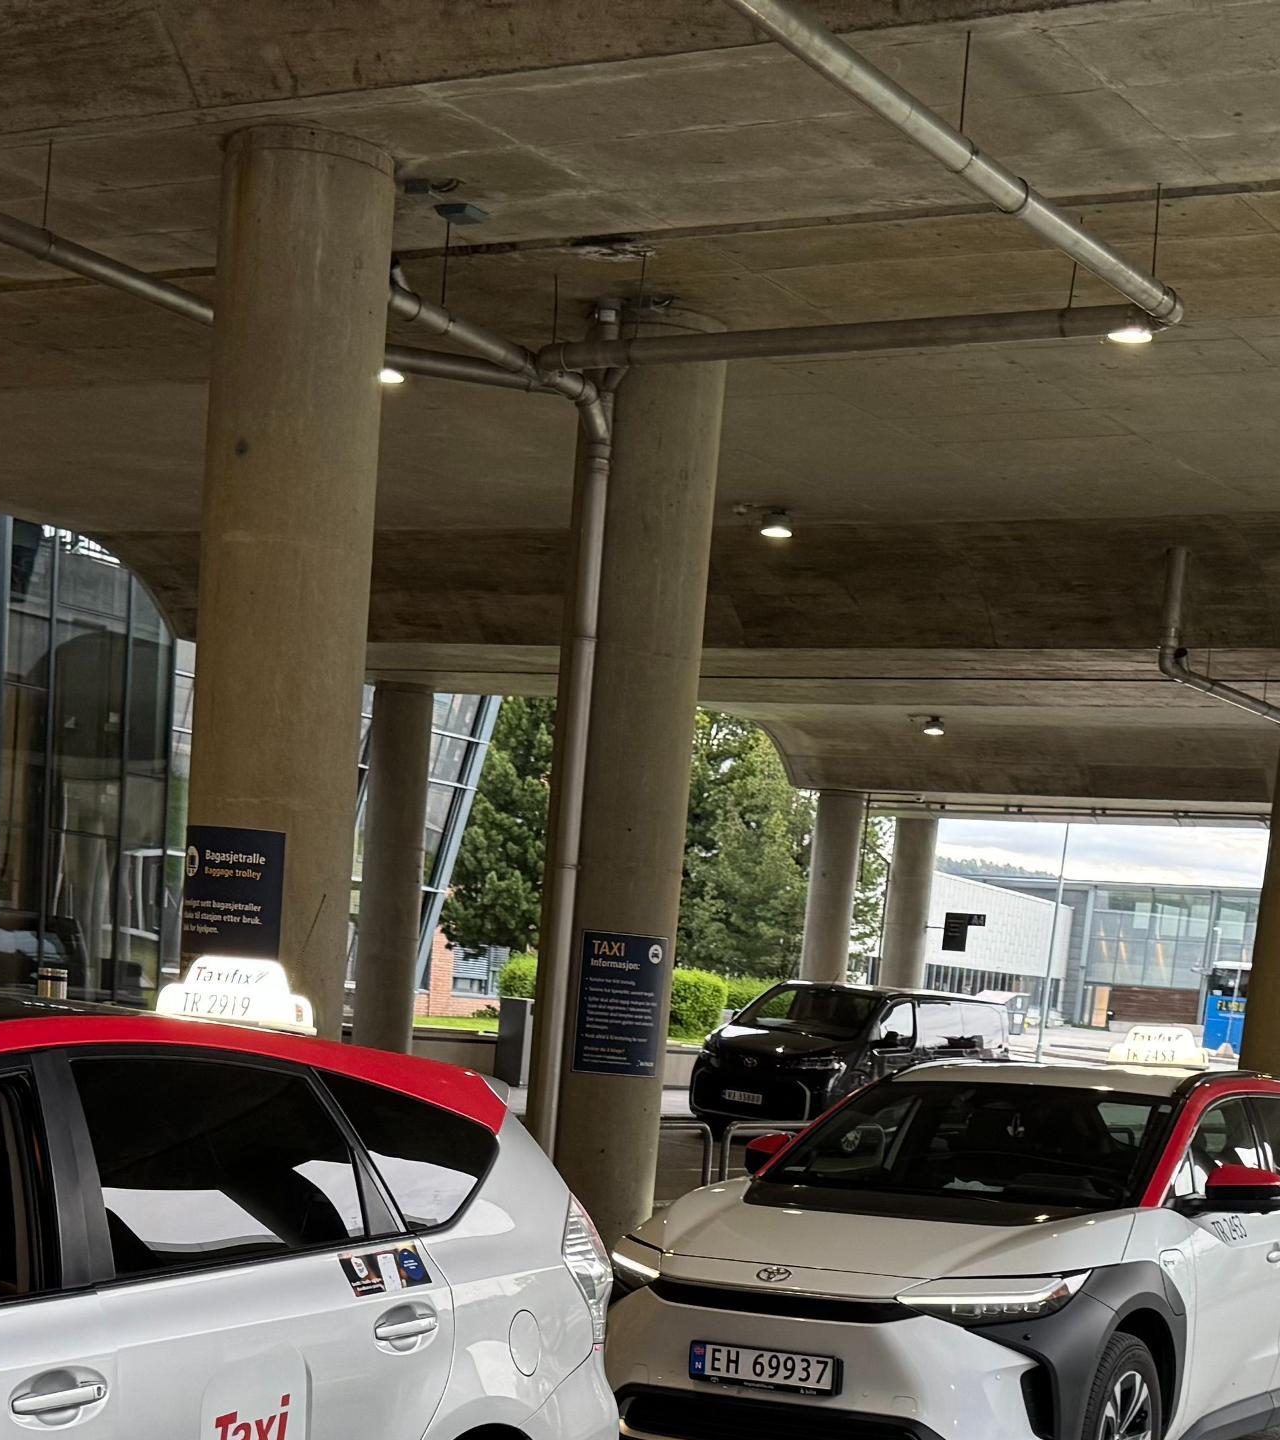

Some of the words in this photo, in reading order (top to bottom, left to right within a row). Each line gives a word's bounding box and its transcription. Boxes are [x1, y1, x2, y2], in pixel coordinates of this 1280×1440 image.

[205, 849, 266, 865] Bagasjetralle
[204, 866, 234, 877] Baggage
[235, 868, 262, 880] trolley
[222, 914, 241, 923] etter
[592, 940, 626, 957] TAXI
[590, 958, 641, 972] Informasjon:
[195, 966, 252, 984] Taxifix
[183, 992, 202, 1013] TR
[207, 994, 251, 1016] 2919
[1211, 1220, 1231, 1243] TR
[1223, 1215, 1247, 1240] 2453
[710, 1347, 740, 1375] EH
[752, 1353, 829, 1384] 69937
